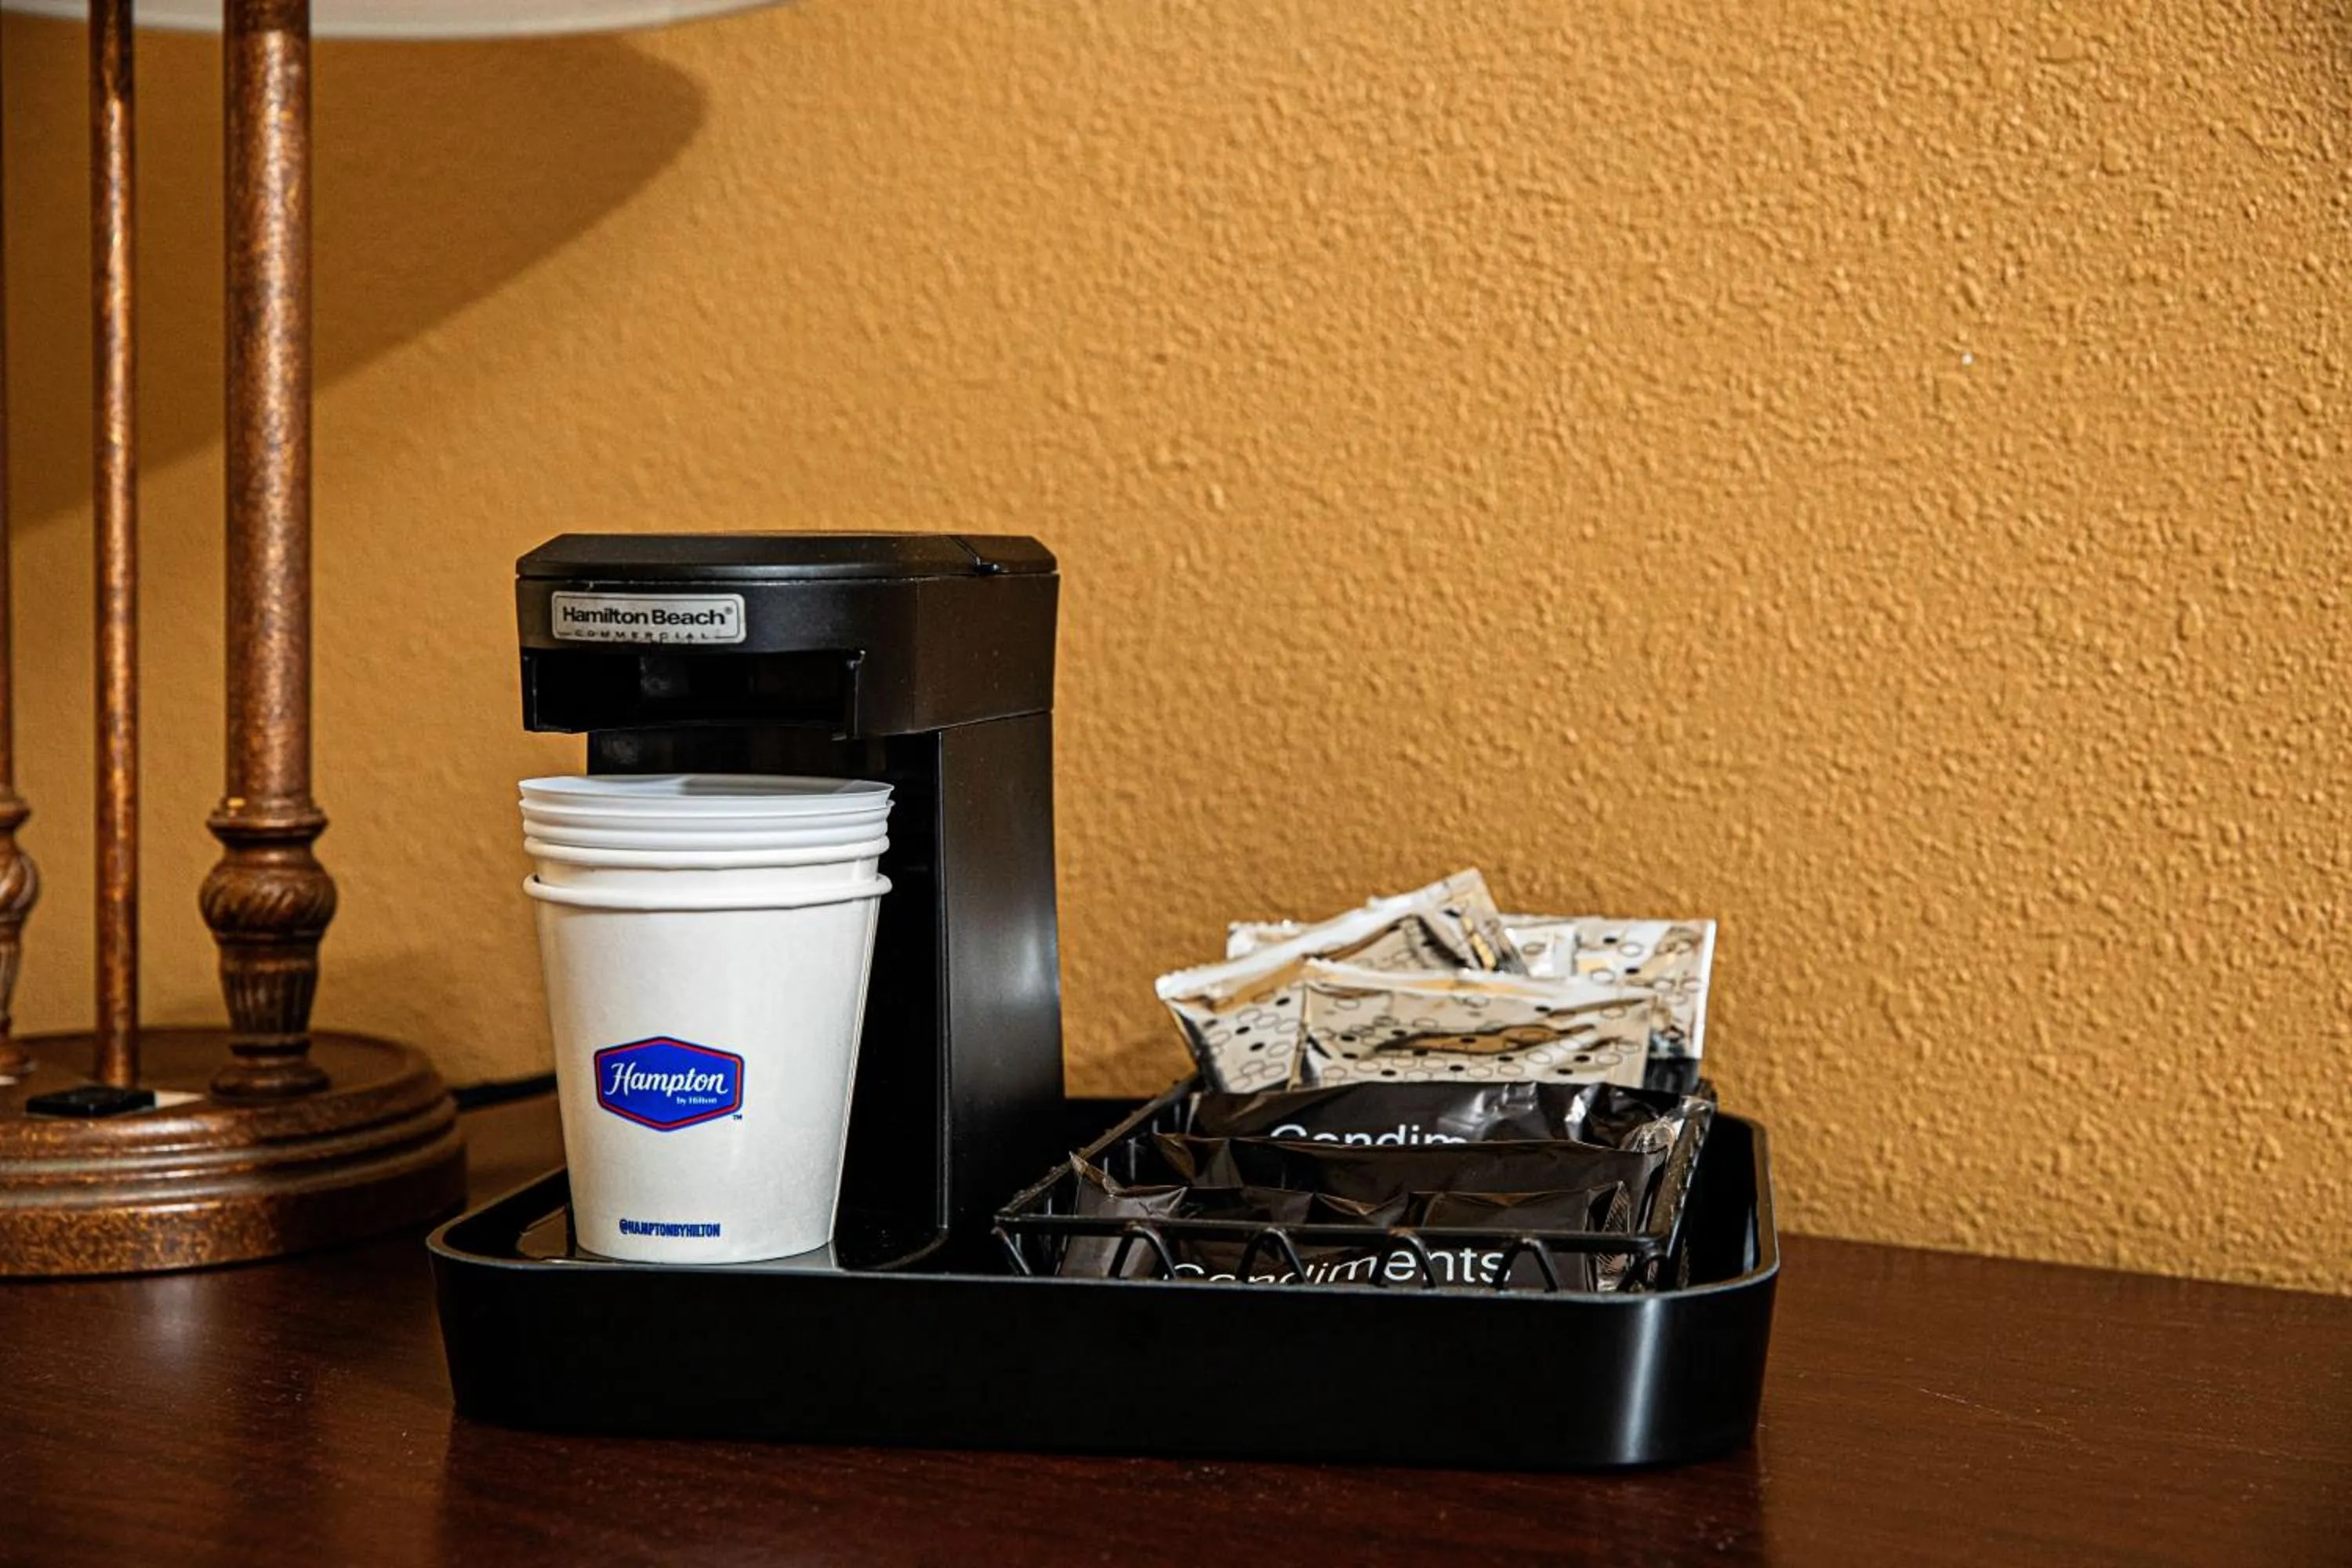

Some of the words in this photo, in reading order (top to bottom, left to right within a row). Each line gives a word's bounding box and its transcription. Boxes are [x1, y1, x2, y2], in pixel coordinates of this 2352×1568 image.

[562, 607, 648, 626] Hamilton
[652, 609, 725, 626] Beach
[604, 1061, 729, 1098] Hampton
[676, 1096, 687, 1106] by
[688, 1096, 718, 1105] Hilton
[619, 1218, 721, 1238] @HAMPTONBYHILTON
[1163, 1247, 1511, 1284] iments
